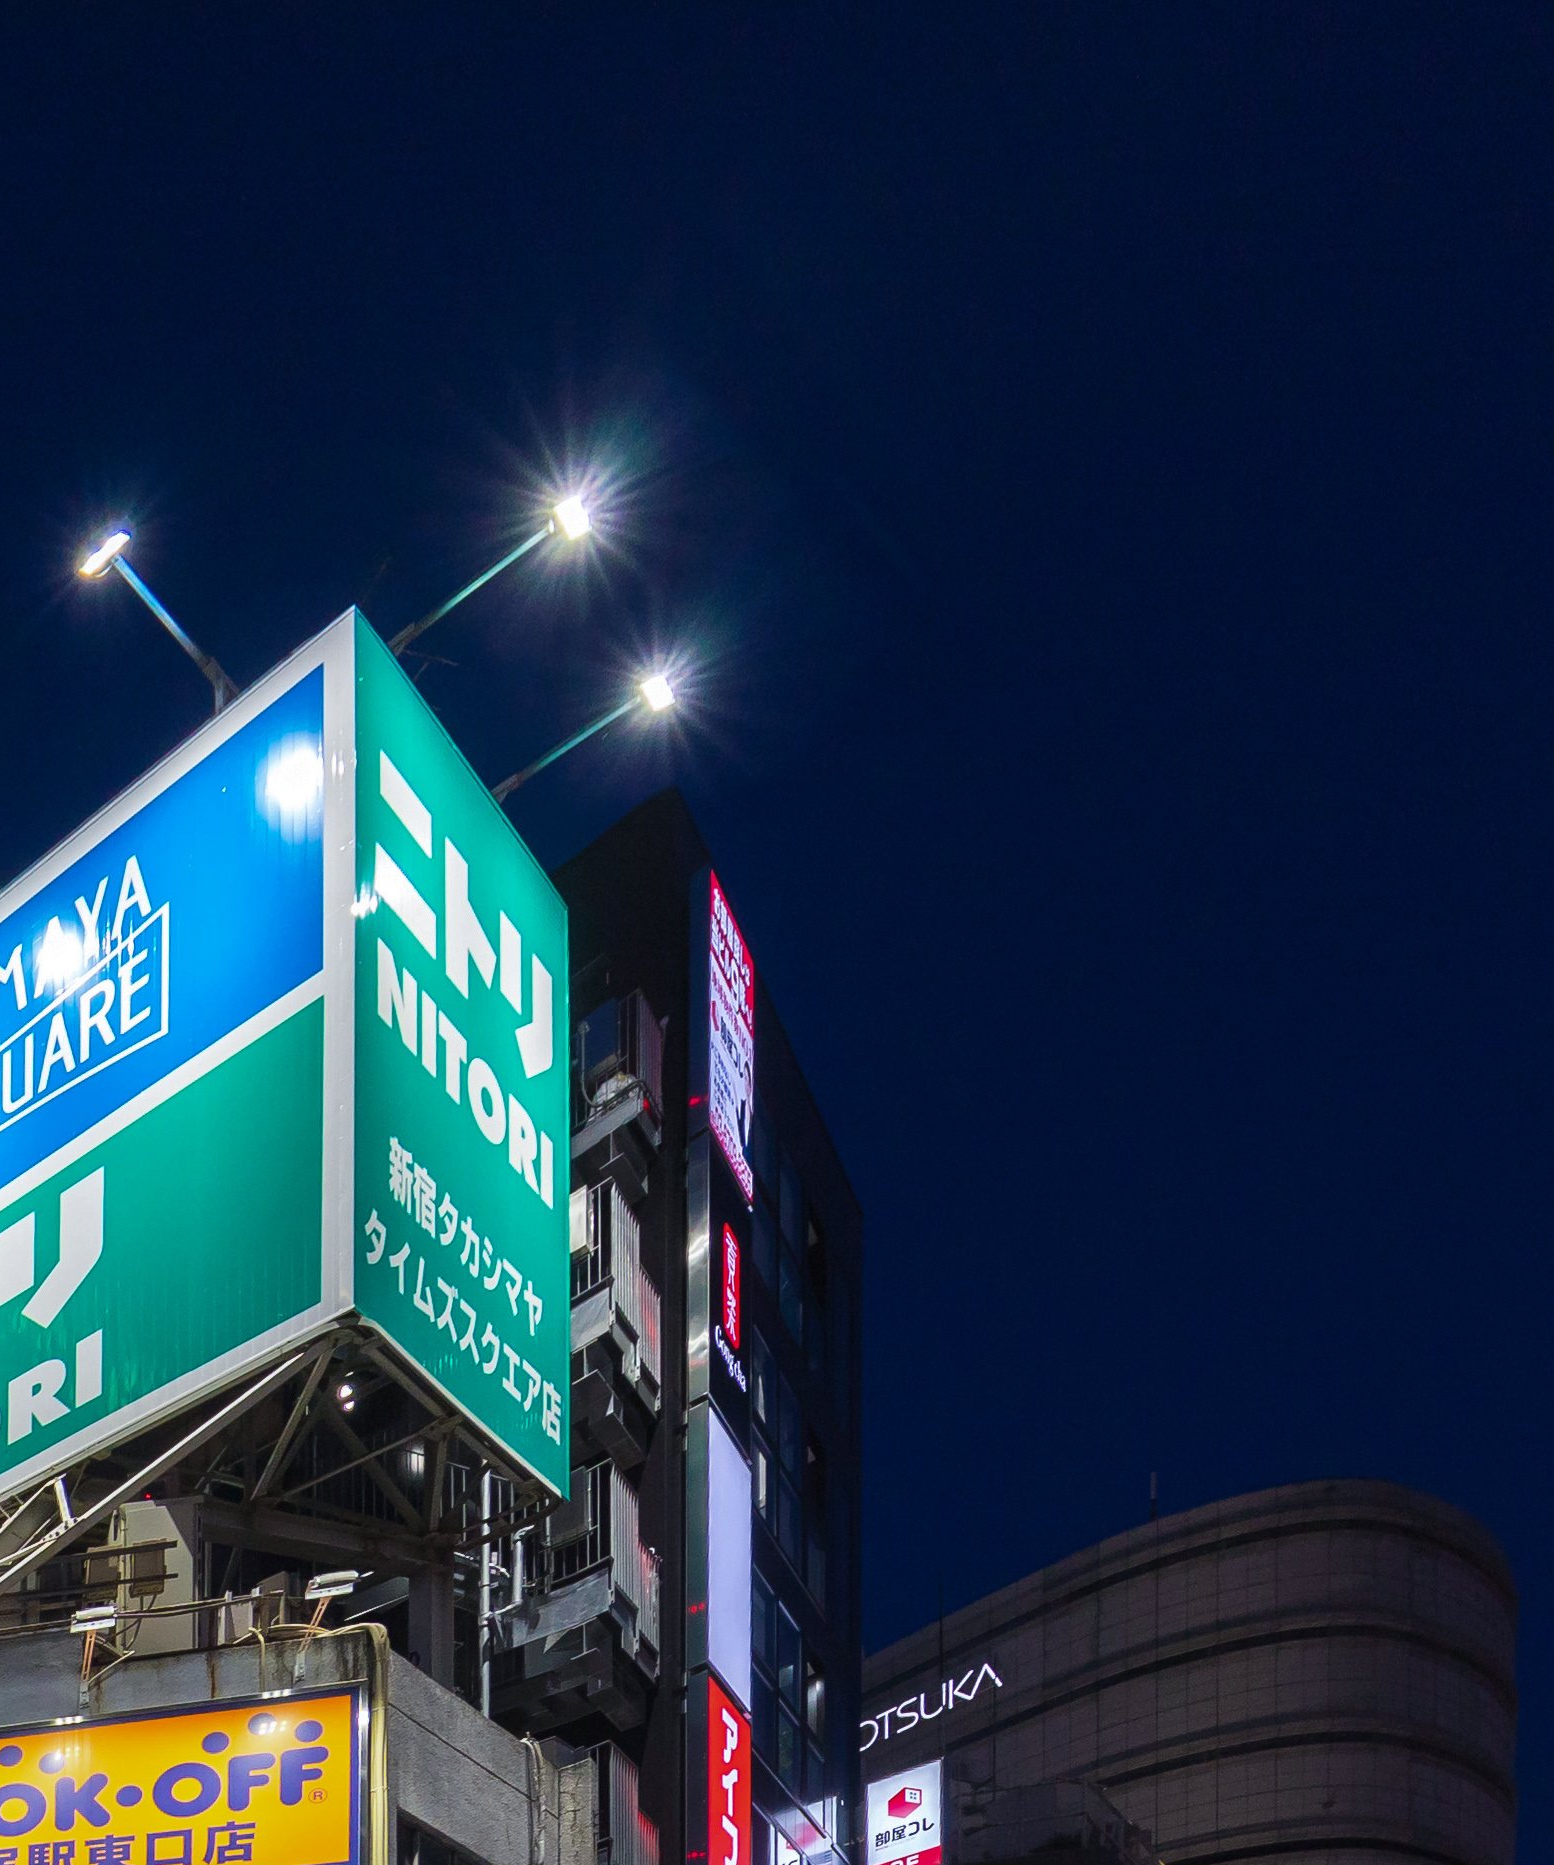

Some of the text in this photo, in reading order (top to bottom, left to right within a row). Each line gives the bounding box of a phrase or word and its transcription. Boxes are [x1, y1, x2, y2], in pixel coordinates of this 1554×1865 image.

[376, 748, 555, 1080] ニトリ
[376, 937, 555, 1210] NITORI
[363, 1206, 563, 1449] タイムズスクエア店
[386, 1134, 546, 1340] 新宿タカシマヤ
[873, 1819, 936, 1849] 部屋コレ
